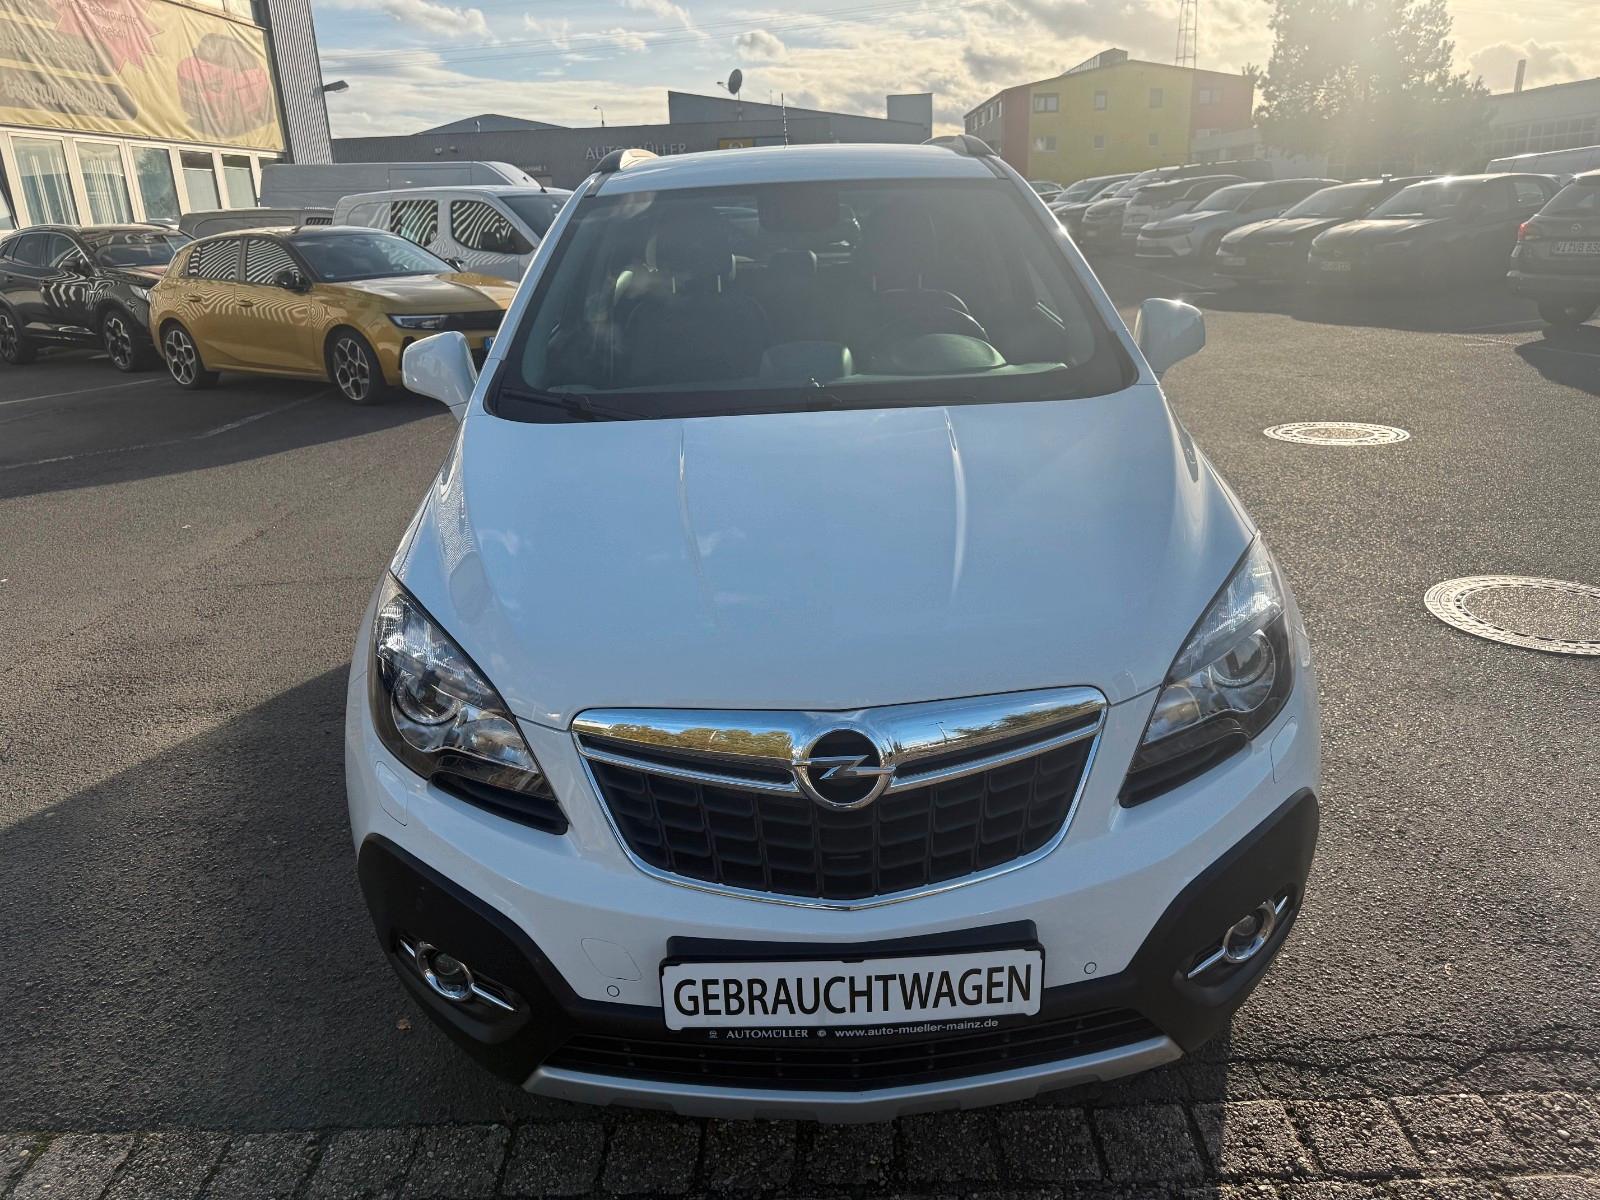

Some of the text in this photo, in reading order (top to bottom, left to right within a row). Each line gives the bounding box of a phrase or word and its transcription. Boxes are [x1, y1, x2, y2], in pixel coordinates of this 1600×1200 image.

[585, 144, 625, 160] AUT
[674, 964, 1032, 1017] GEBRAUCHTWAGEN
[726, 1018, 999, 1039] AUTOMÜLLER www.auto-mueller-mainz.de
